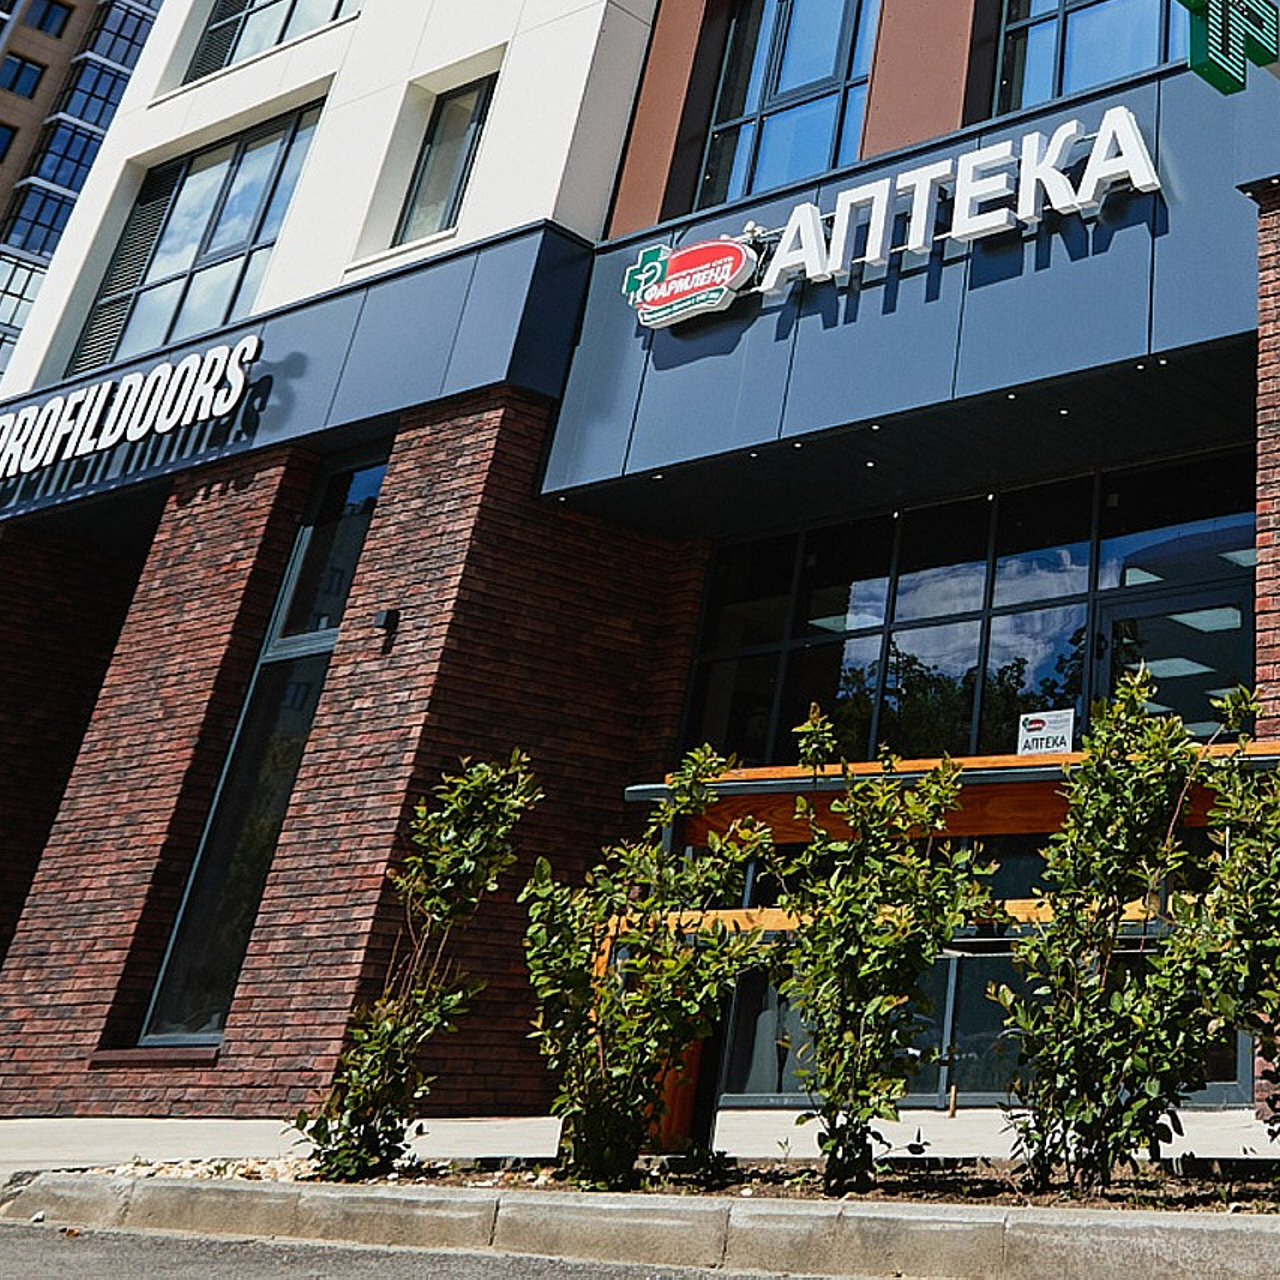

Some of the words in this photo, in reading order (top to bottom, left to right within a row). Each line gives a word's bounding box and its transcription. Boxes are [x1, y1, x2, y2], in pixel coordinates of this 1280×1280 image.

[758, 106, 1161, 293] АПТЕКА
[643, 261, 734, 301] ФАРМЛЕНД
[1023, 735, 1067, 750] АПТЕКА
